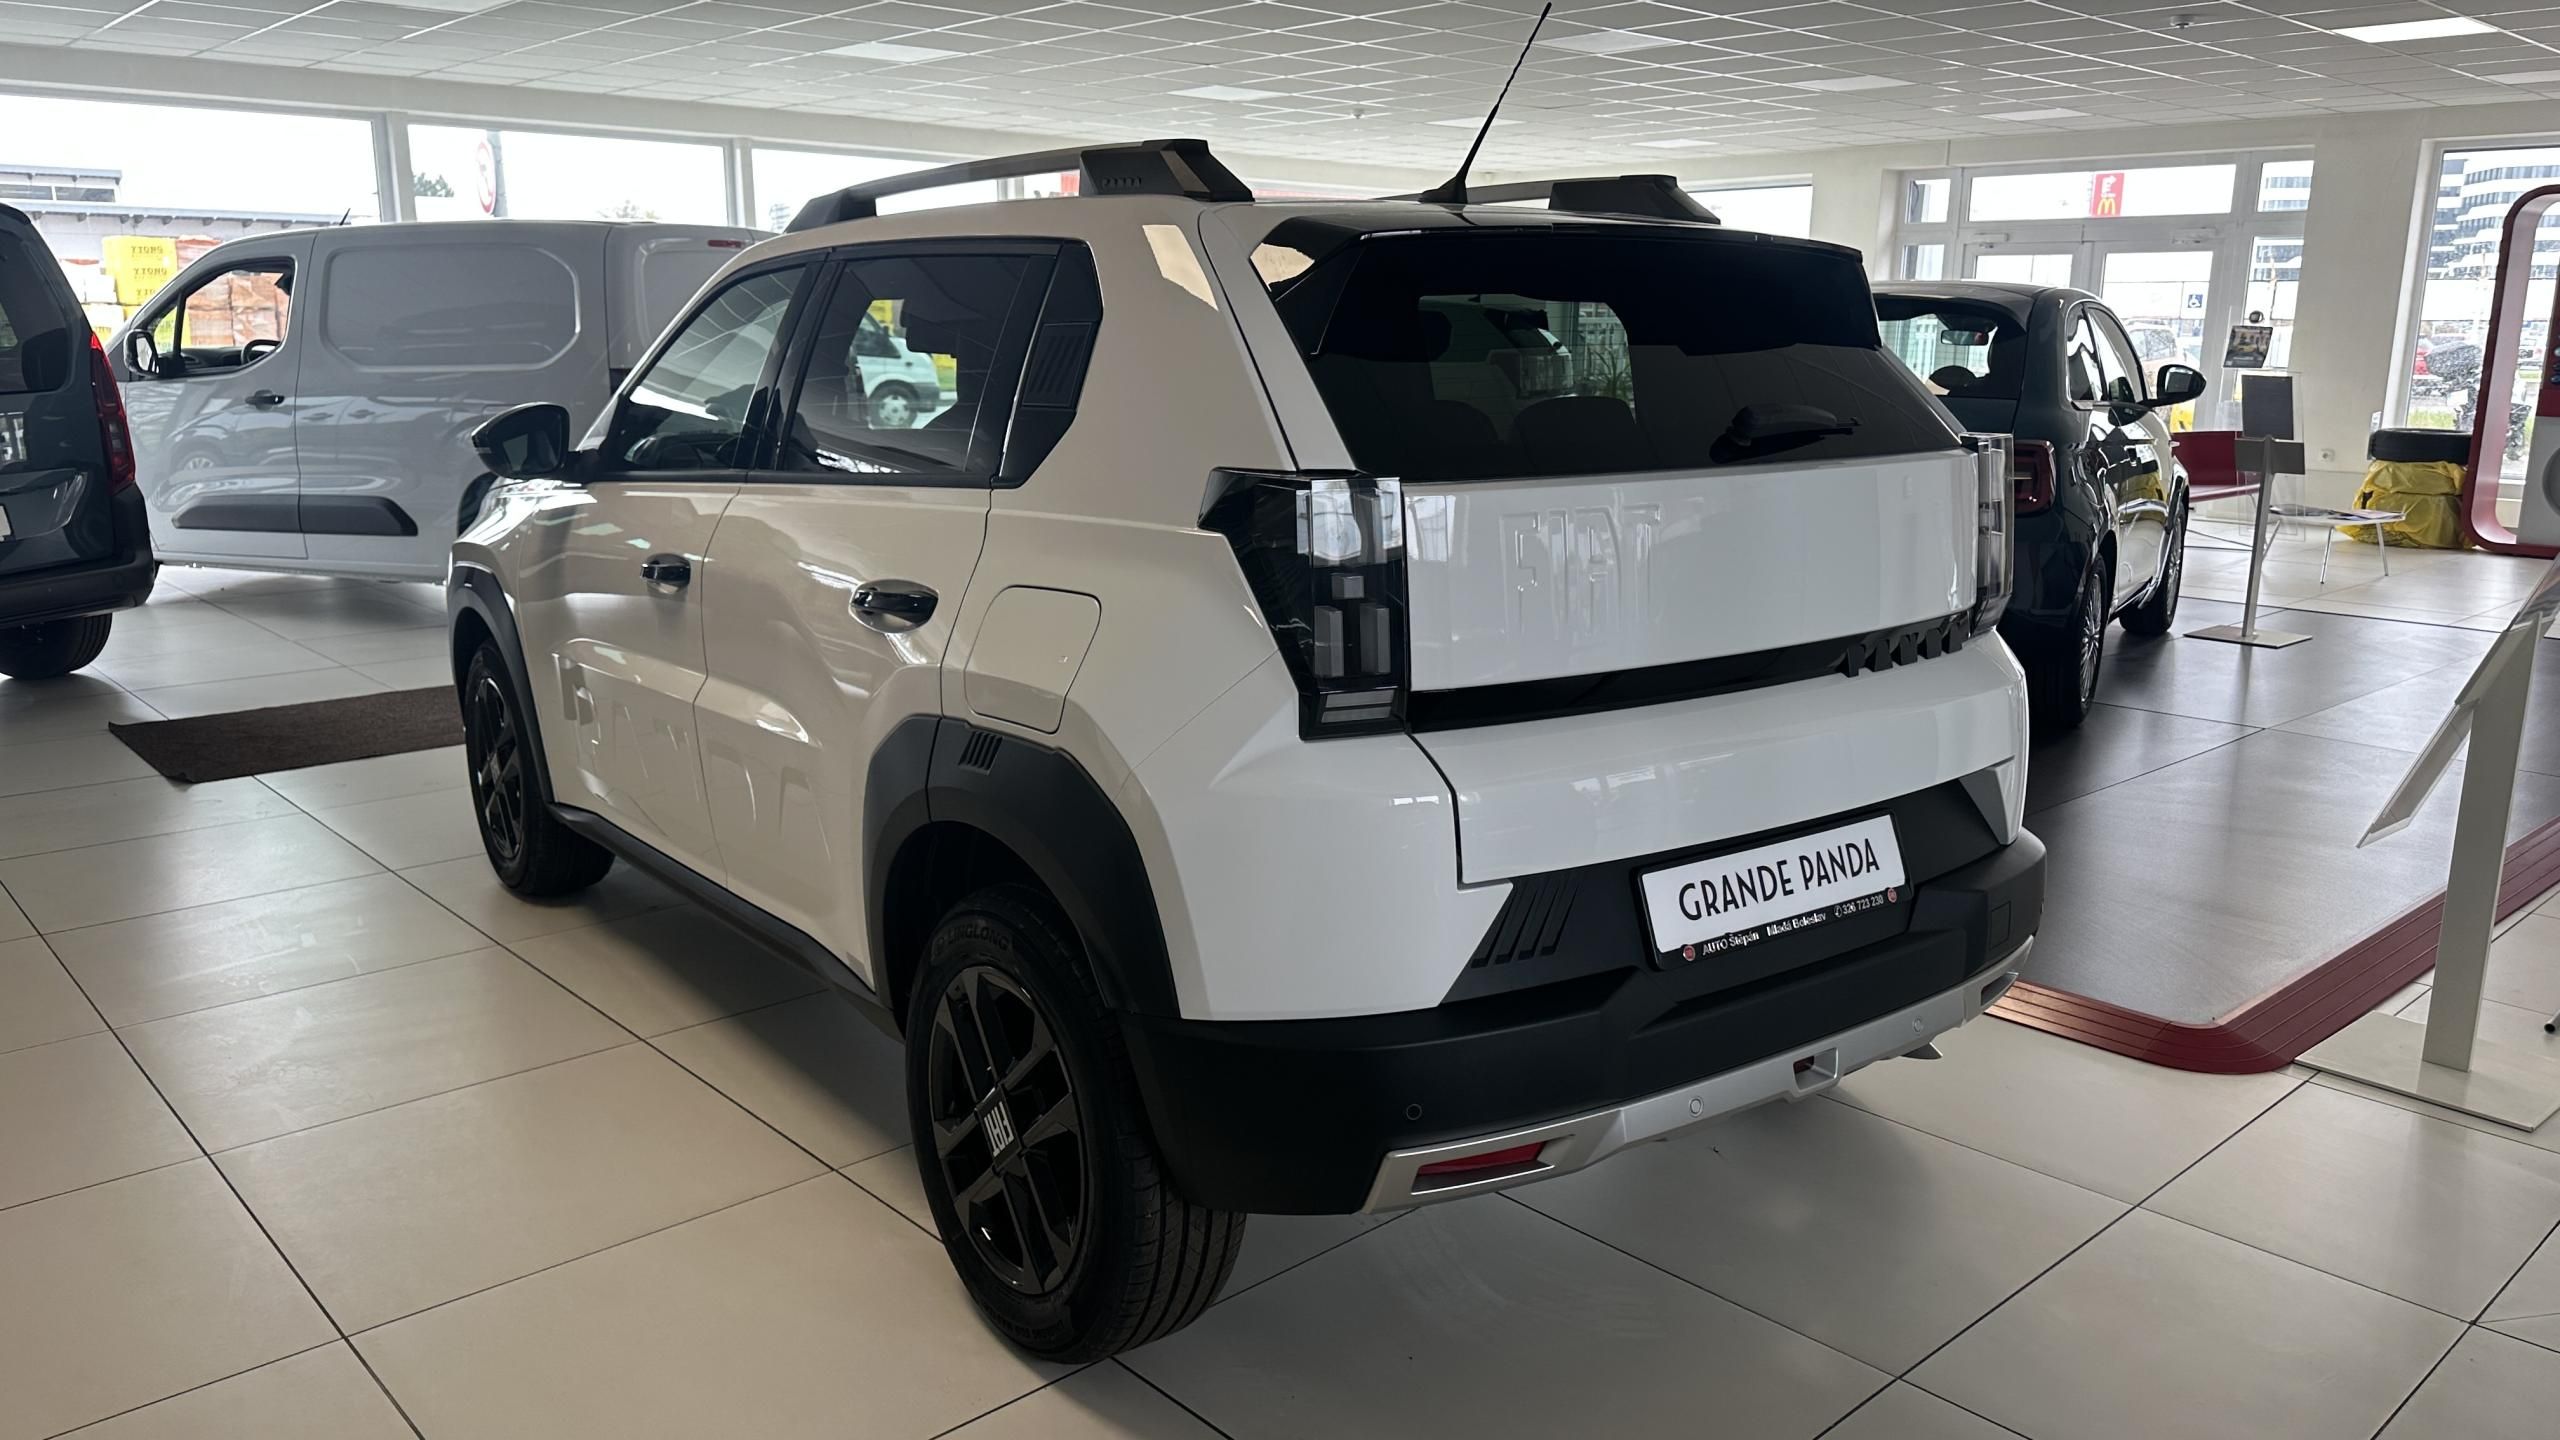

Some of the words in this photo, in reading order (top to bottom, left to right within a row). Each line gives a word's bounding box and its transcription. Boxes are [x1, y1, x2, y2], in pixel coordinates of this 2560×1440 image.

[1499, 503, 1662, 640] FIAT
[1679, 859, 1794, 921] GRANDE
[1799, 838, 1880, 891] PANDA
[1703, 938, 1728, 956] AUTO
[1729, 931, 1760, 947] Štěpán
[1766, 921, 1793, 937] Mladá
[1792, 912, 1826, 929] Boleslav
[1842, 902, 1857, 915] 326
[1857, 898, 1871, 911] 723
[1871, 894, 1884, 907] 230
[984, 1101, 1015, 1158] FIAT
